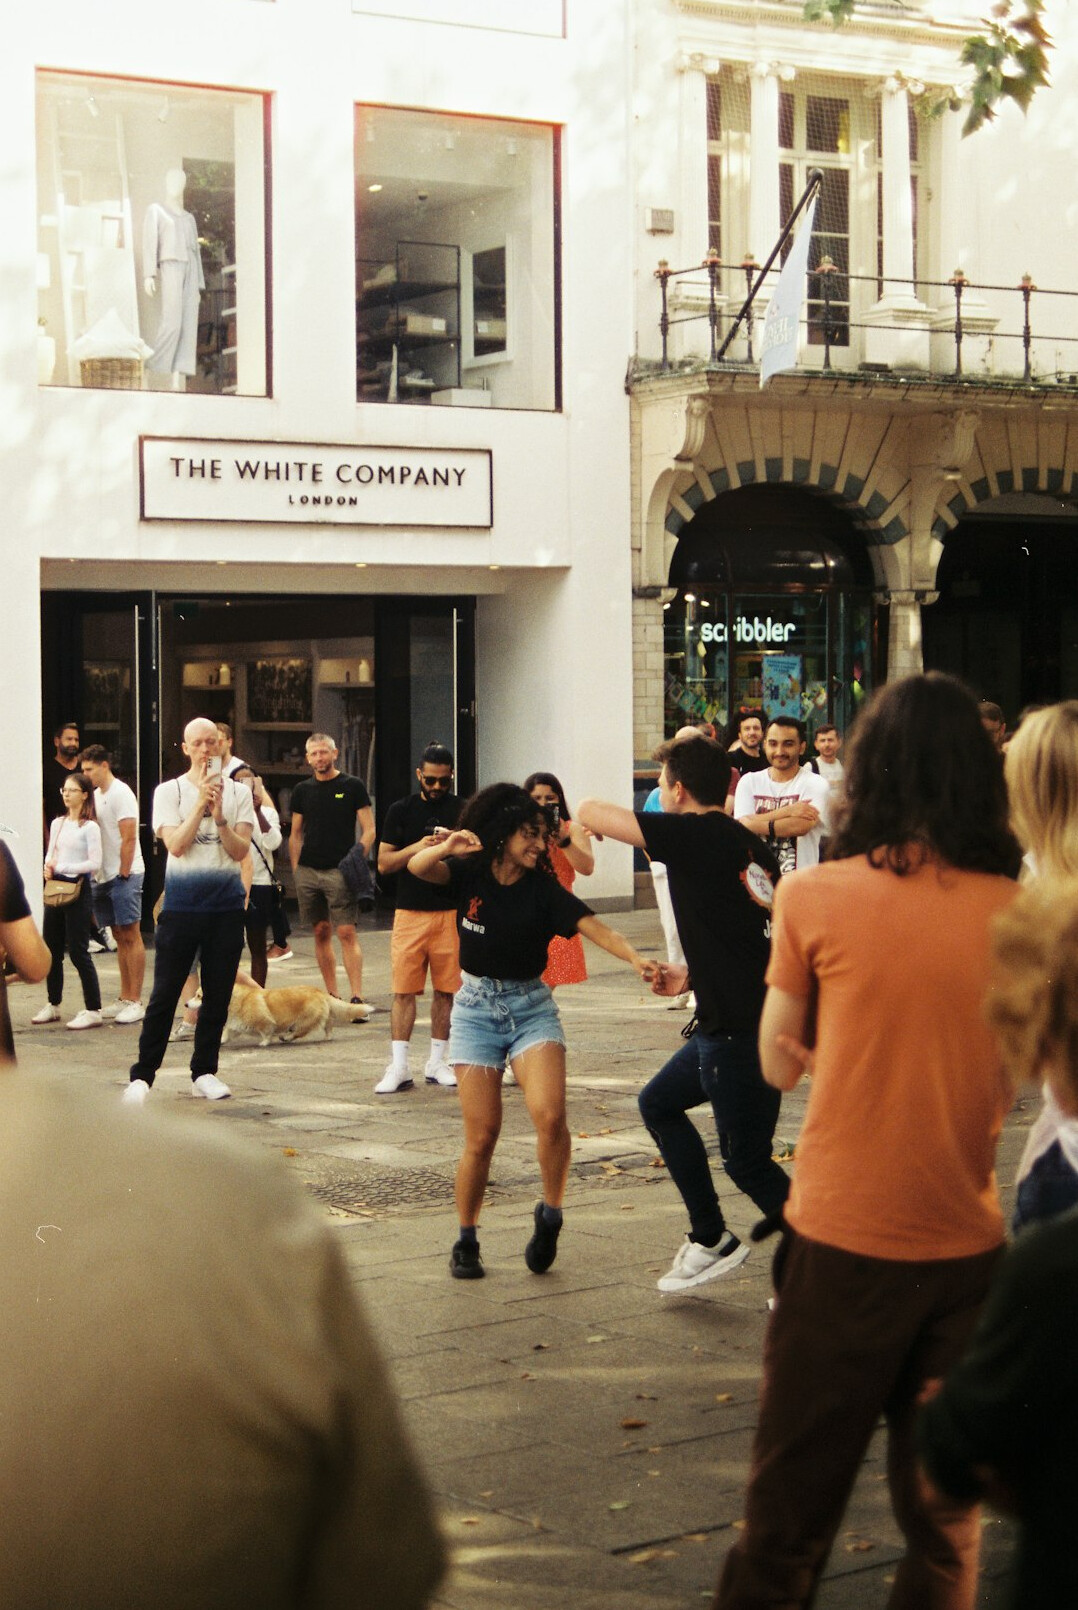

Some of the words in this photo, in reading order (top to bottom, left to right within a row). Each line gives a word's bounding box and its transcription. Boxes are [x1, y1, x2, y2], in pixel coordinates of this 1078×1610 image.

[170, 457, 222, 479] THE
[236, 460, 324, 483] WHITE
[336, 464, 466, 487] COMPANY
[288, 494, 359, 507] LONDON
